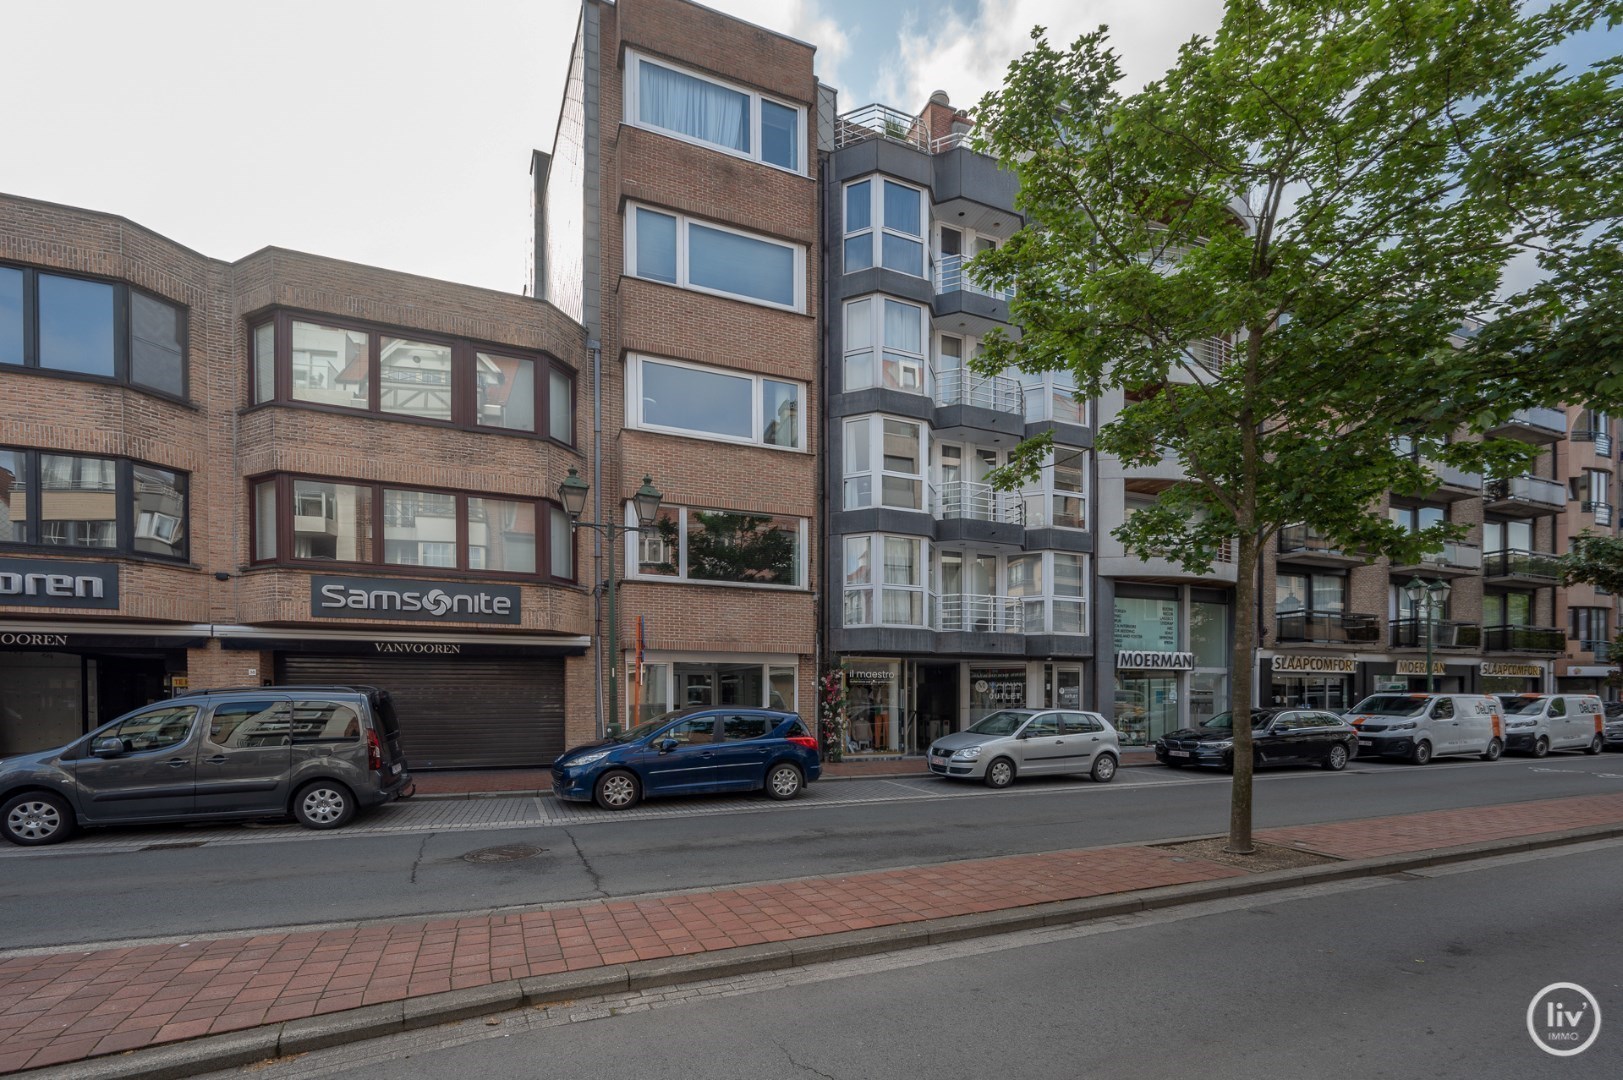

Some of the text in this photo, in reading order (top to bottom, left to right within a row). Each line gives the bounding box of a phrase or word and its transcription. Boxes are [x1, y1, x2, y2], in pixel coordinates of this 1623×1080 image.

[321, 584, 512, 616] Samsonite
[0, 633, 68, 646] OOREN
[375, 642, 461, 654] VANVOOREN
[1119, 652, 1192, 668] MOERMAN
[1399, 660, 1446, 673] MOERAN
[856, 670, 895, 679] maestro
